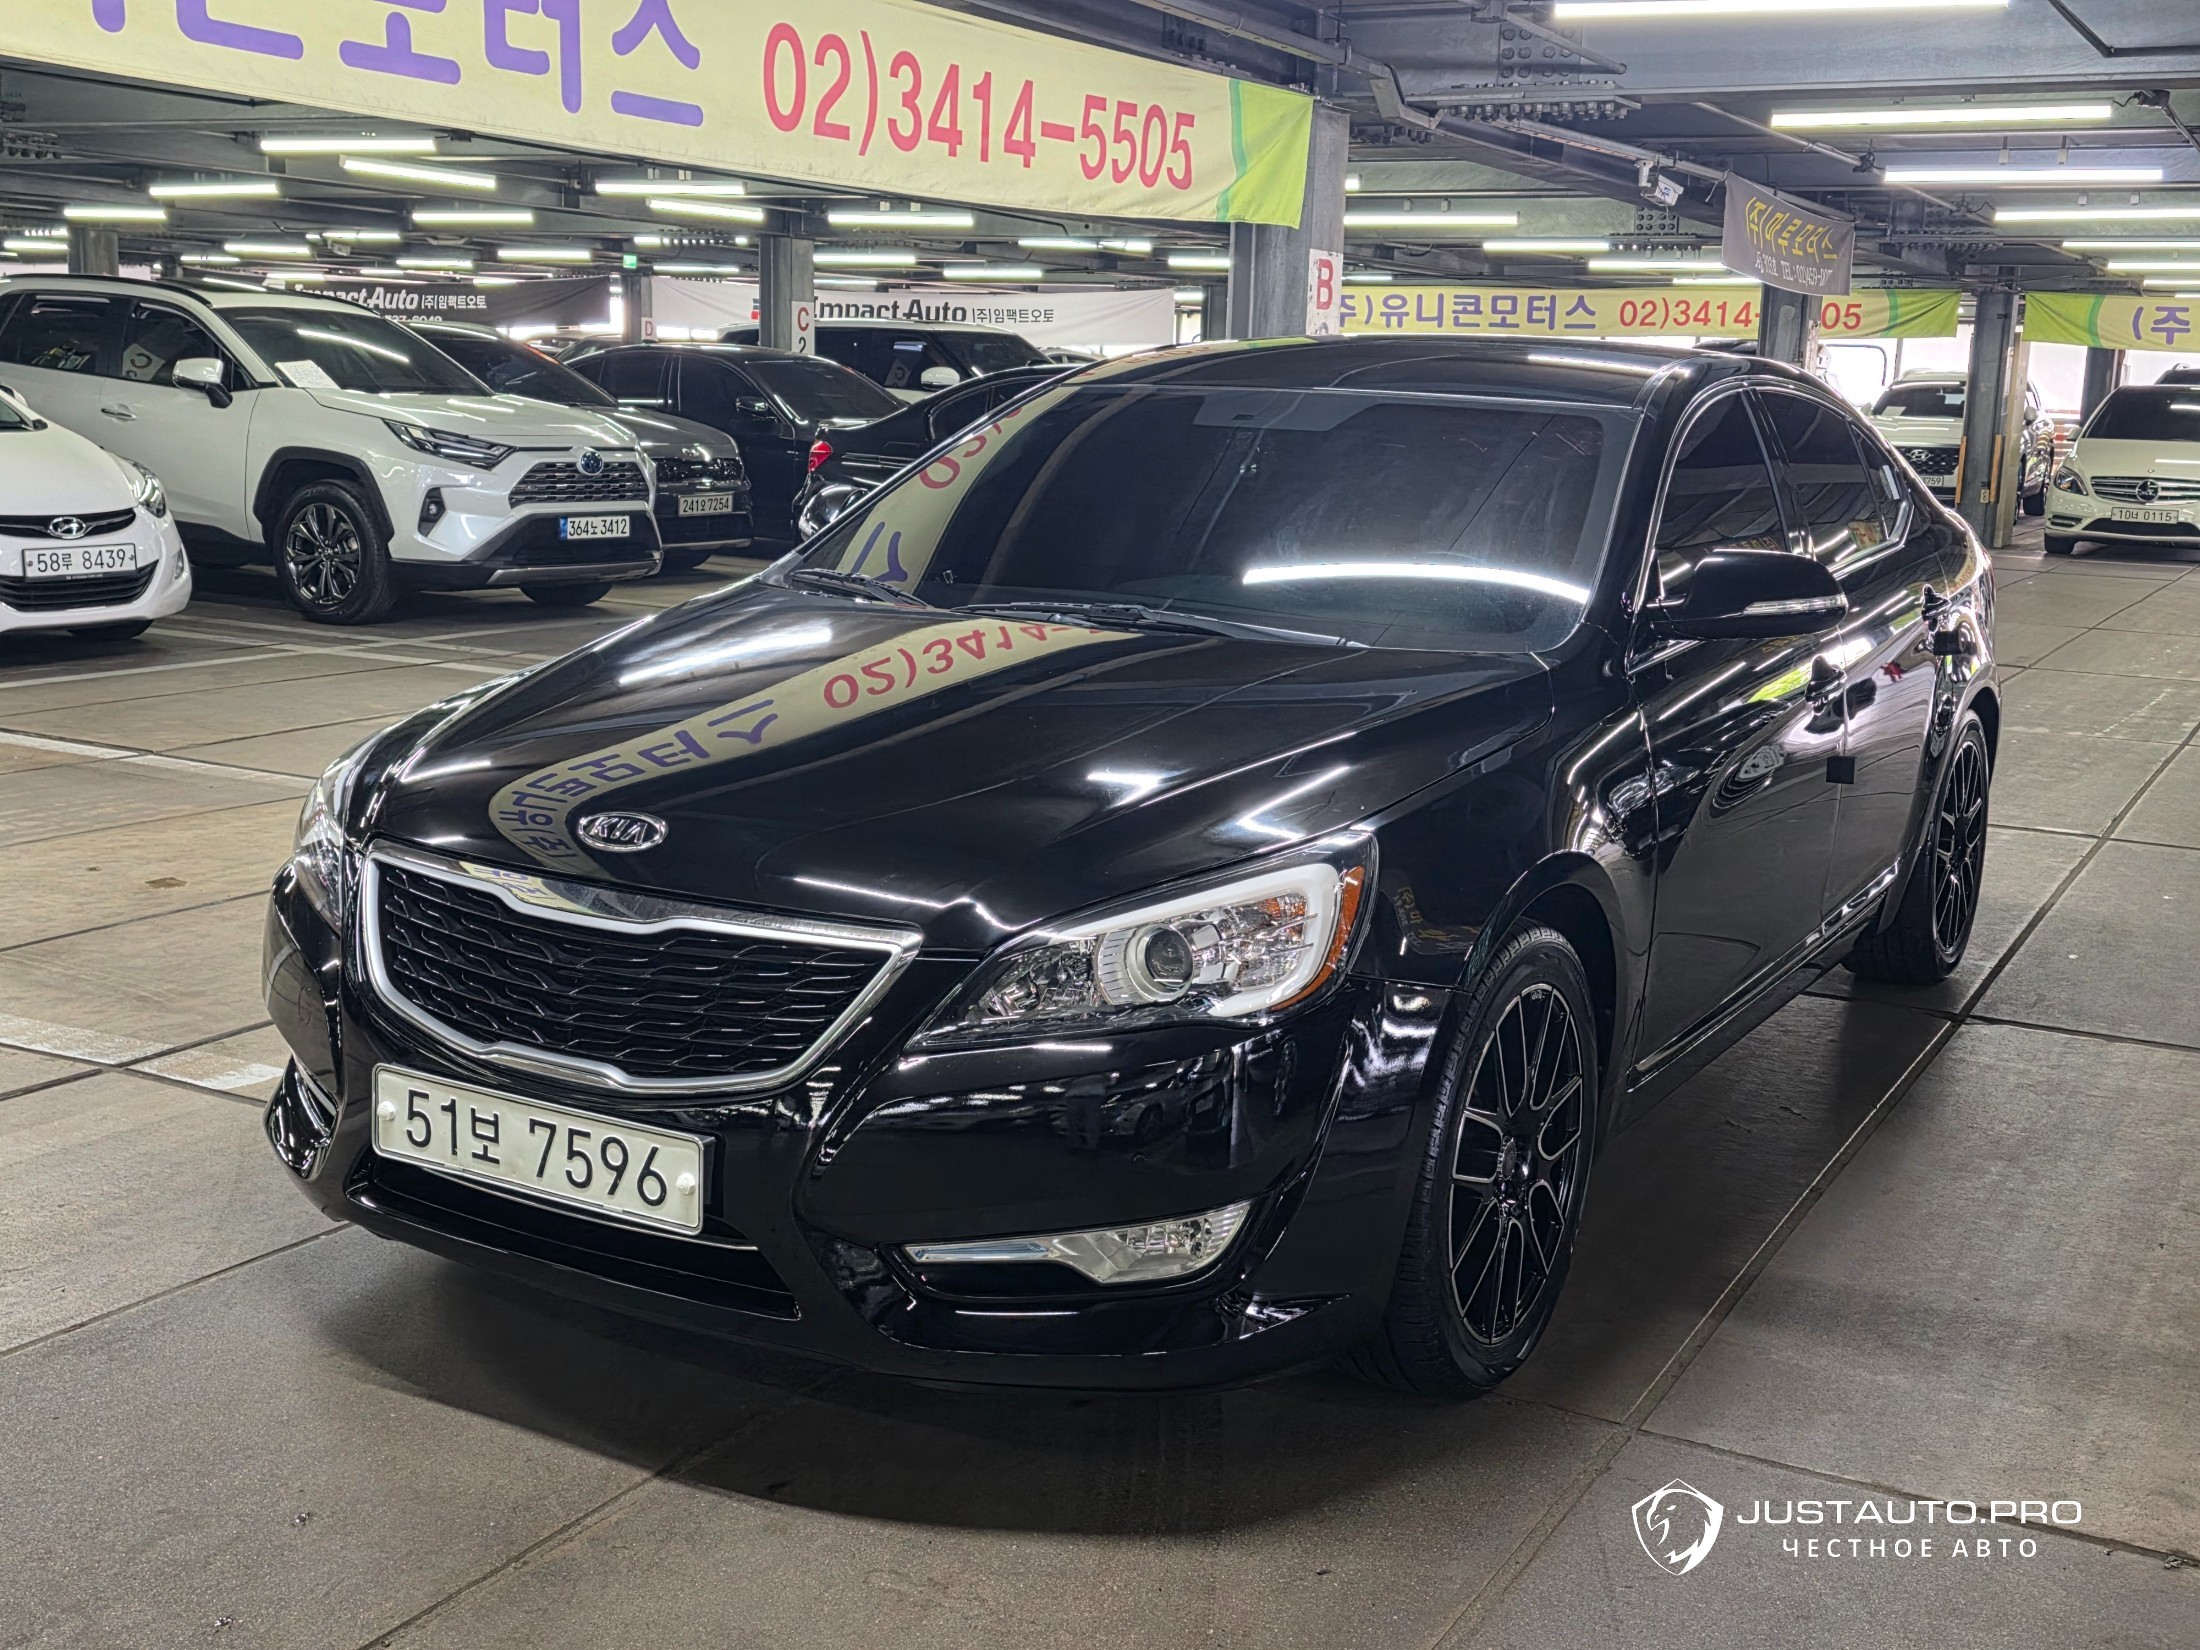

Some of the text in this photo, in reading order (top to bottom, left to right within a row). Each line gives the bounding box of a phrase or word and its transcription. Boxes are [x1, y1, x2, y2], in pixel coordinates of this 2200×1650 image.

[763, 22, 1196, 191] 02)3414-5505
[1316, 258, 1334, 311] B
[366, 287, 418, 309] Auto
[797, 306, 810, 332] C
[902, 299, 967, 322] Auto
[707, 497, 730, 511] 7254
[568, 518, 628, 537] 364노 3412
[2144, 511, 2173, 522] 0115
[37, 548, 126, 572] 58루 8439
[406, 1088, 669, 1208] 51보 7596
